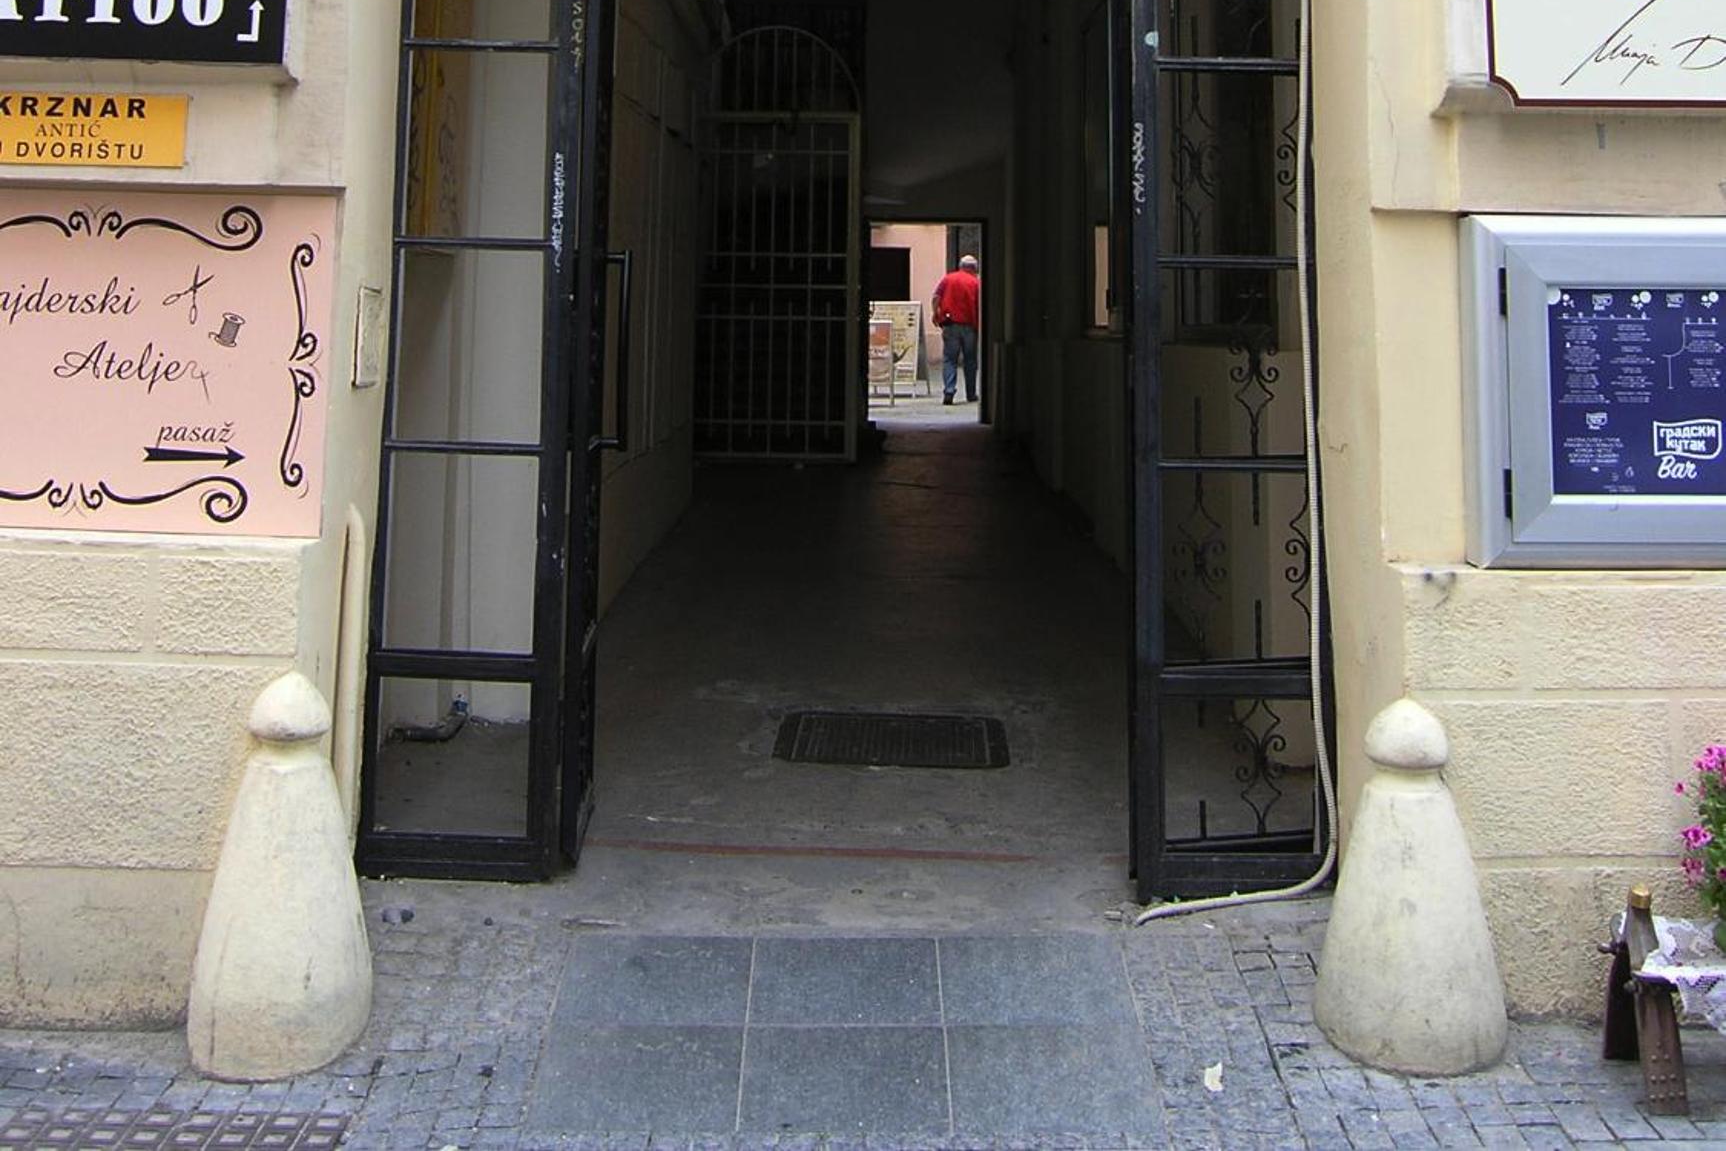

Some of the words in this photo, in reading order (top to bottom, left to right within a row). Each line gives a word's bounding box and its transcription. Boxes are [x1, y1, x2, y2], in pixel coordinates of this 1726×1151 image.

[35, 120, 101, 138] ANTIĆ
[16, 139, 144, 160] DVORIŠTU
[54, 340, 190, 394] Atelje
[156, 421, 234, 449] pasaž
[1657, 455, 1698, 479] Bar
